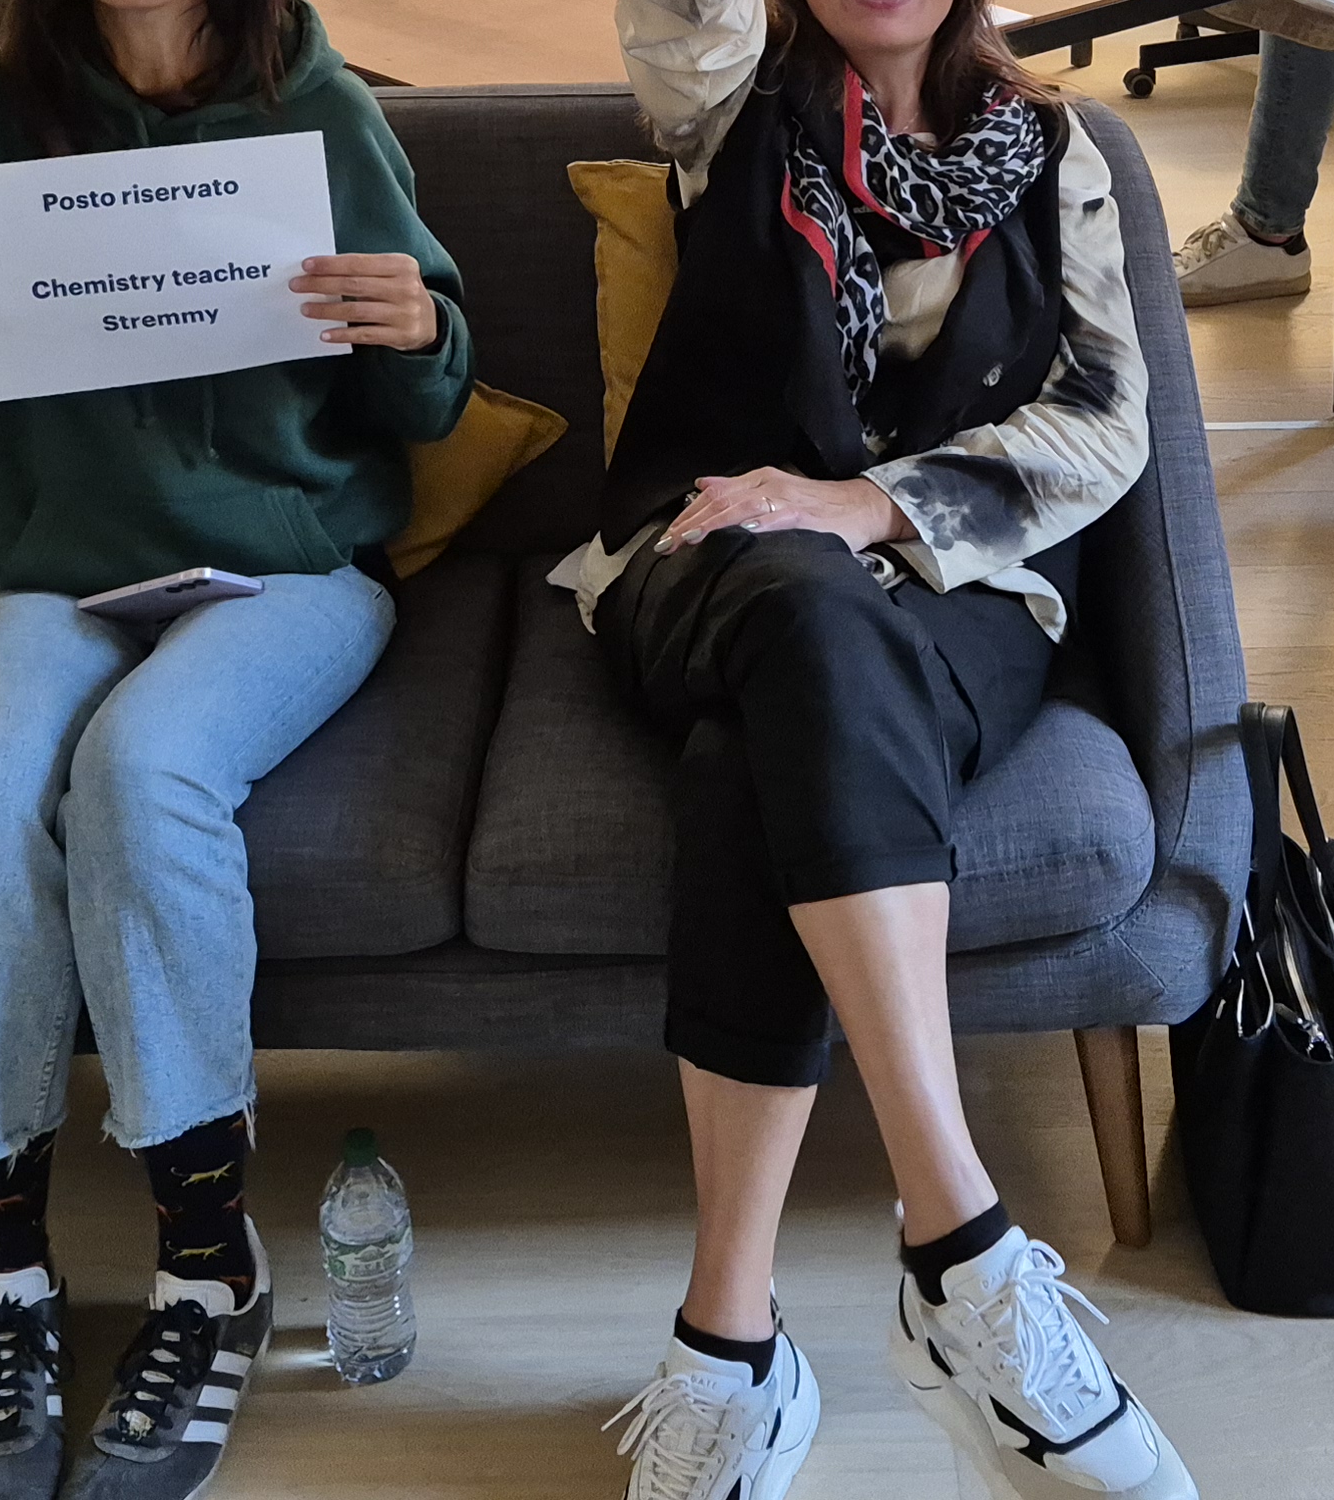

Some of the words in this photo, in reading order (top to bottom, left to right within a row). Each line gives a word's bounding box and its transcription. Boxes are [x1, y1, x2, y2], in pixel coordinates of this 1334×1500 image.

[42, 191, 117, 212] Posto
[122, 177, 240, 206] riservato
[31, 274, 166, 301] Chemistry
[172, 261, 272, 288] teacher
[102, 308, 219, 332] Stremmy
